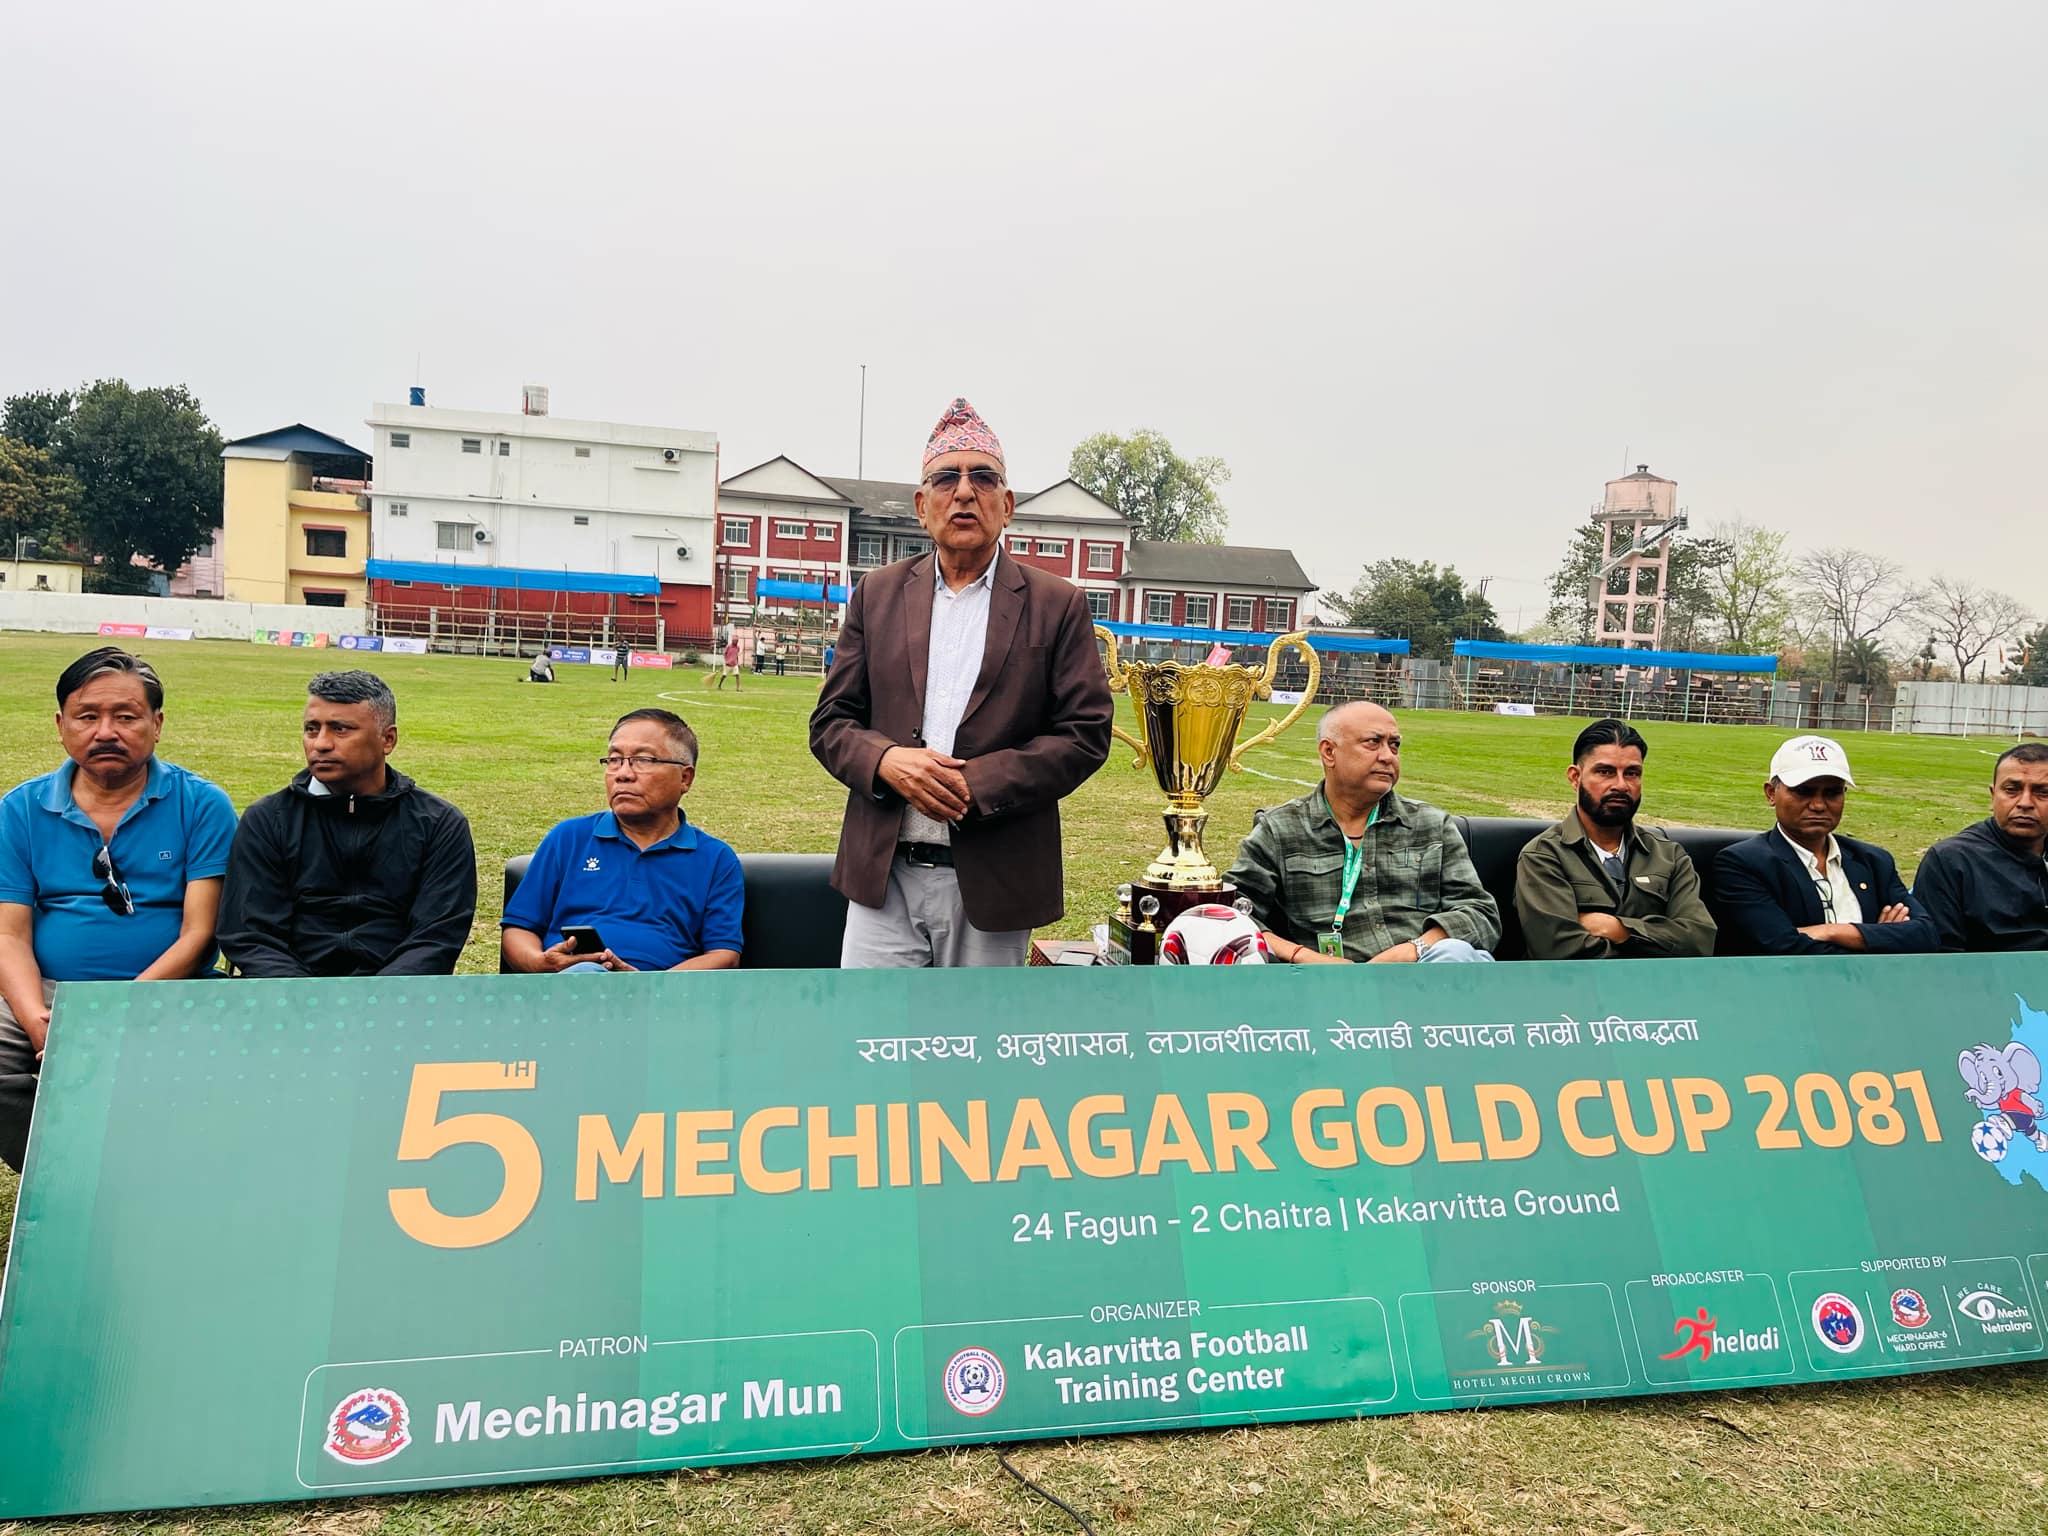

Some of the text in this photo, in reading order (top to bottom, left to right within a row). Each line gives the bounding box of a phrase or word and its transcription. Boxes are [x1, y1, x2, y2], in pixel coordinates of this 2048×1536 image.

[856, 1014, 1700, 1066] स्वास्थ्य, अनुशासन, लगनशीलता, खेलाडी उत्पादन हाम्रो प्रतिबद्धता
[575, 1091, 1278, 1201] MECHINAGAR
[1291, 1081, 1543, 1170] GOLD
[1557, 1077, 1733, 1157] CUP
[1744, 1069, 1943, 1150] 2081
[1012, 1213, 1054, 1243] 24
[1065, 1211, 1158, 1245] Fagun
[1192, 1206, 1211, 1233] 2
[1219, 1201, 1332, 1232] Chaitra
[1355, 1192, 1508, 1226] Kakarvitta
[1514, 1187, 1621, 1216] Ground
[1860, 1255, 1948, 1273] SUPPORTED BY
[1471, 1279, 1537, 1295] SPONSOR
[1651, 1269, 1745, 1287] BROADCASTER
[1956, 1282, 2003, 1299] WE CARE
[1090, 1299, 1202, 1323] ORGANIZER
[1996, 1305, 2029, 1319] Mechi
[1886, 1330, 1948, 1343] MECHINAGAR-6
[1982, 1320, 2033, 1334] Netralaya
[558, 1335, 649, 1359] PATRON
[1023, 1325, 1309, 1370] Kakarvitta Football
[1489, 1317, 1542, 1366] M
[1893, 1340, 1947, 1352] WARD OFFICE
[1055, 1364, 1286, 1405] Training Center
[1453, 1371, 1592, 1390] HOTEL MECHI CROWN
[434, 1378, 843, 1444] Mechinagar Mun
